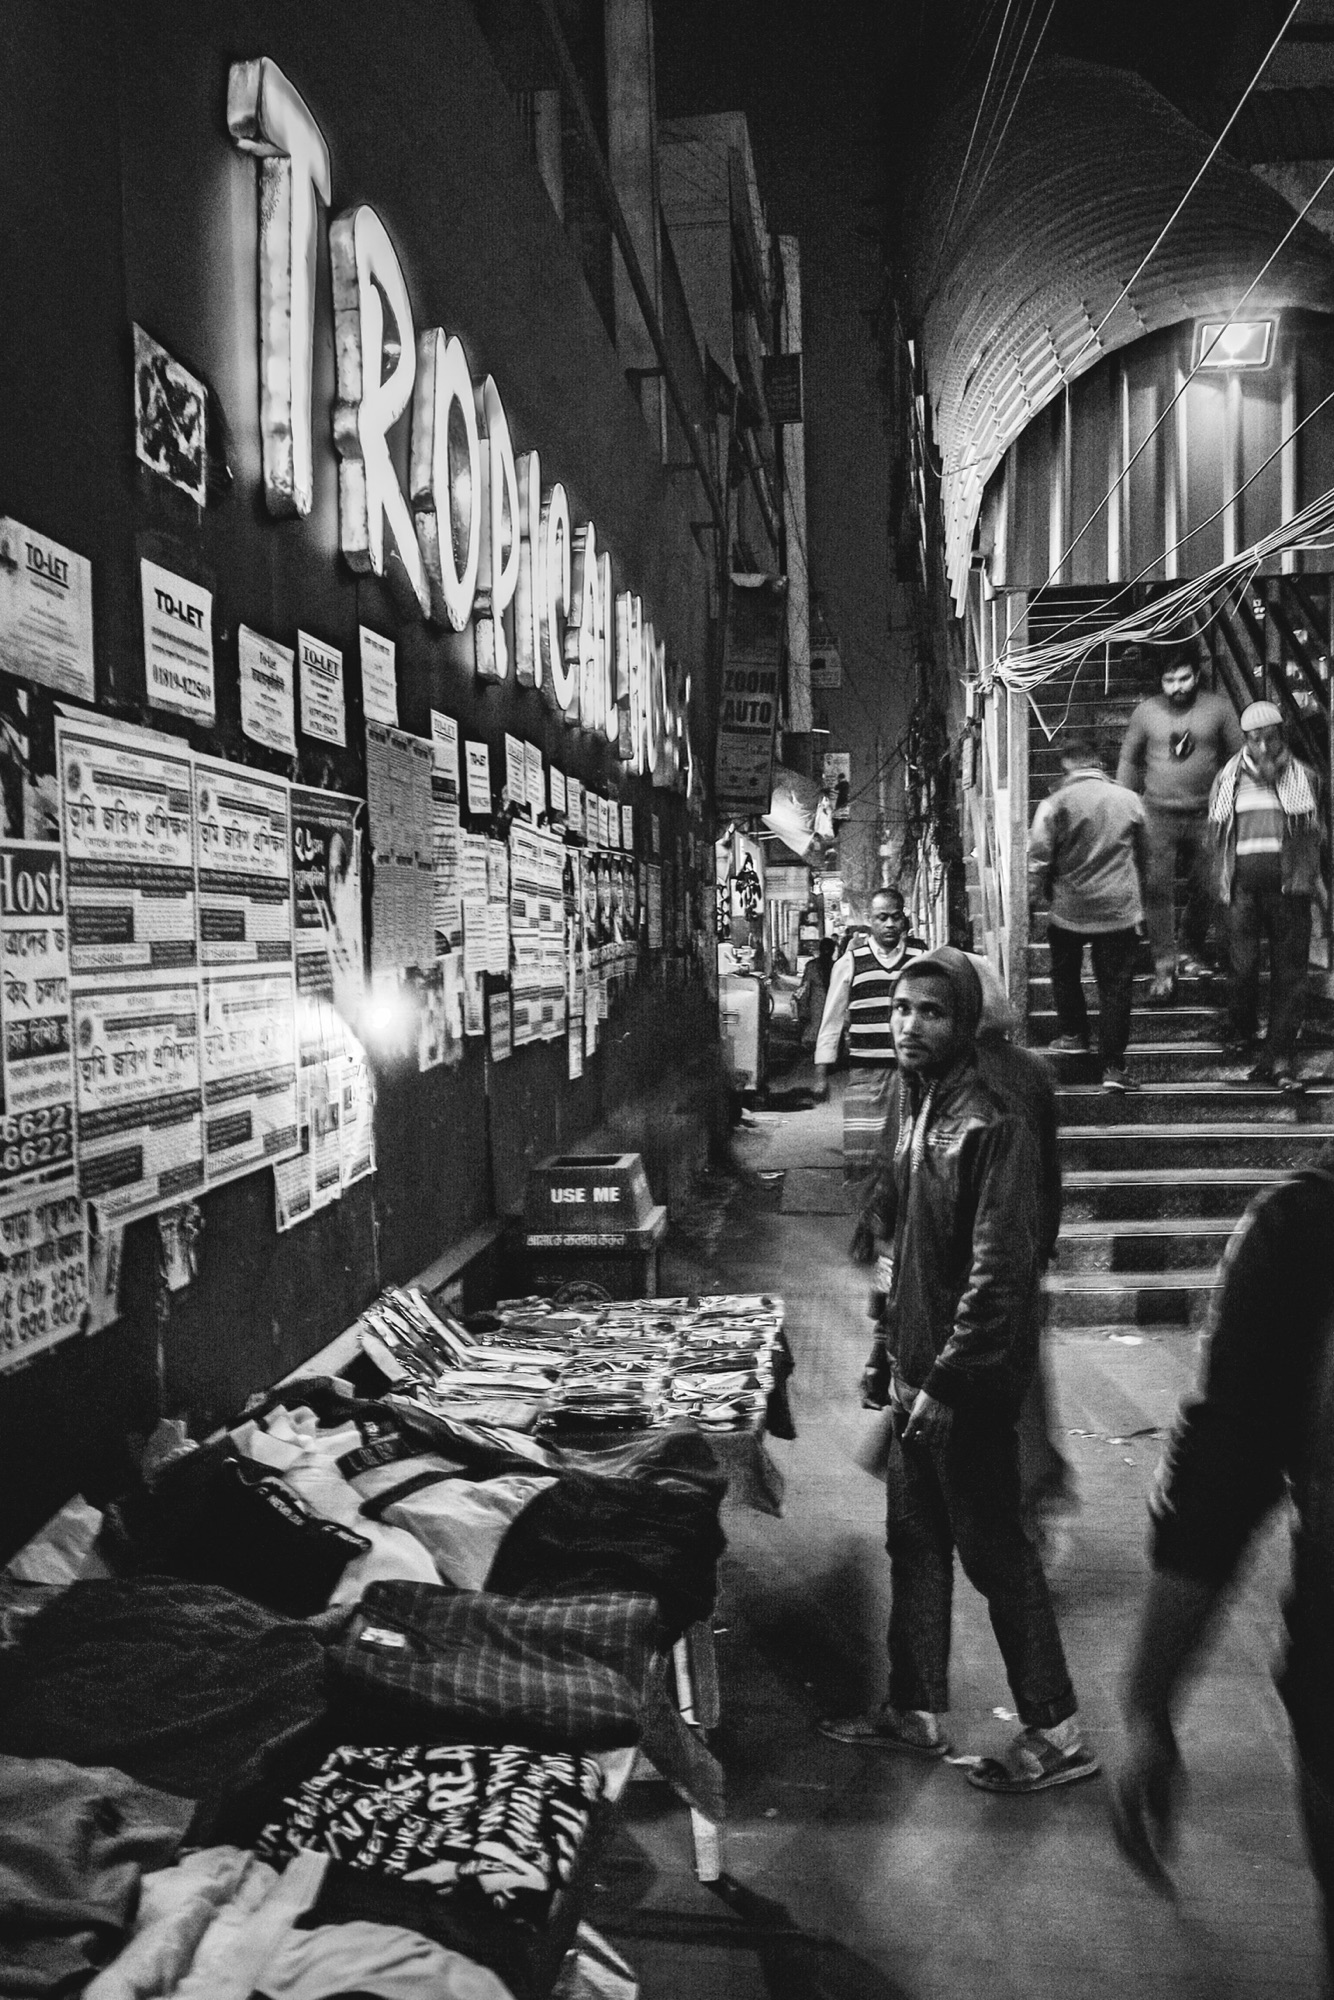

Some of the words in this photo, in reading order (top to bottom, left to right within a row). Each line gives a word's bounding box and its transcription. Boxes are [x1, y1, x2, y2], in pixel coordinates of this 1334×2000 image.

[25, 541, 69, 583] TO-LET
[154, 587, 204, 629] TO-LET
[303, 645, 339, 677] TO-LET
[725, 670, 777, 693] ZOOM
[723, 700, 772, 724] AUTO
[0, 1106, 67, 1143] 6622
[0, 1133, 68, 1171] 6622
[551, 1187, 586, 1203] USE
[593, 1187, 620, 1202] ME
